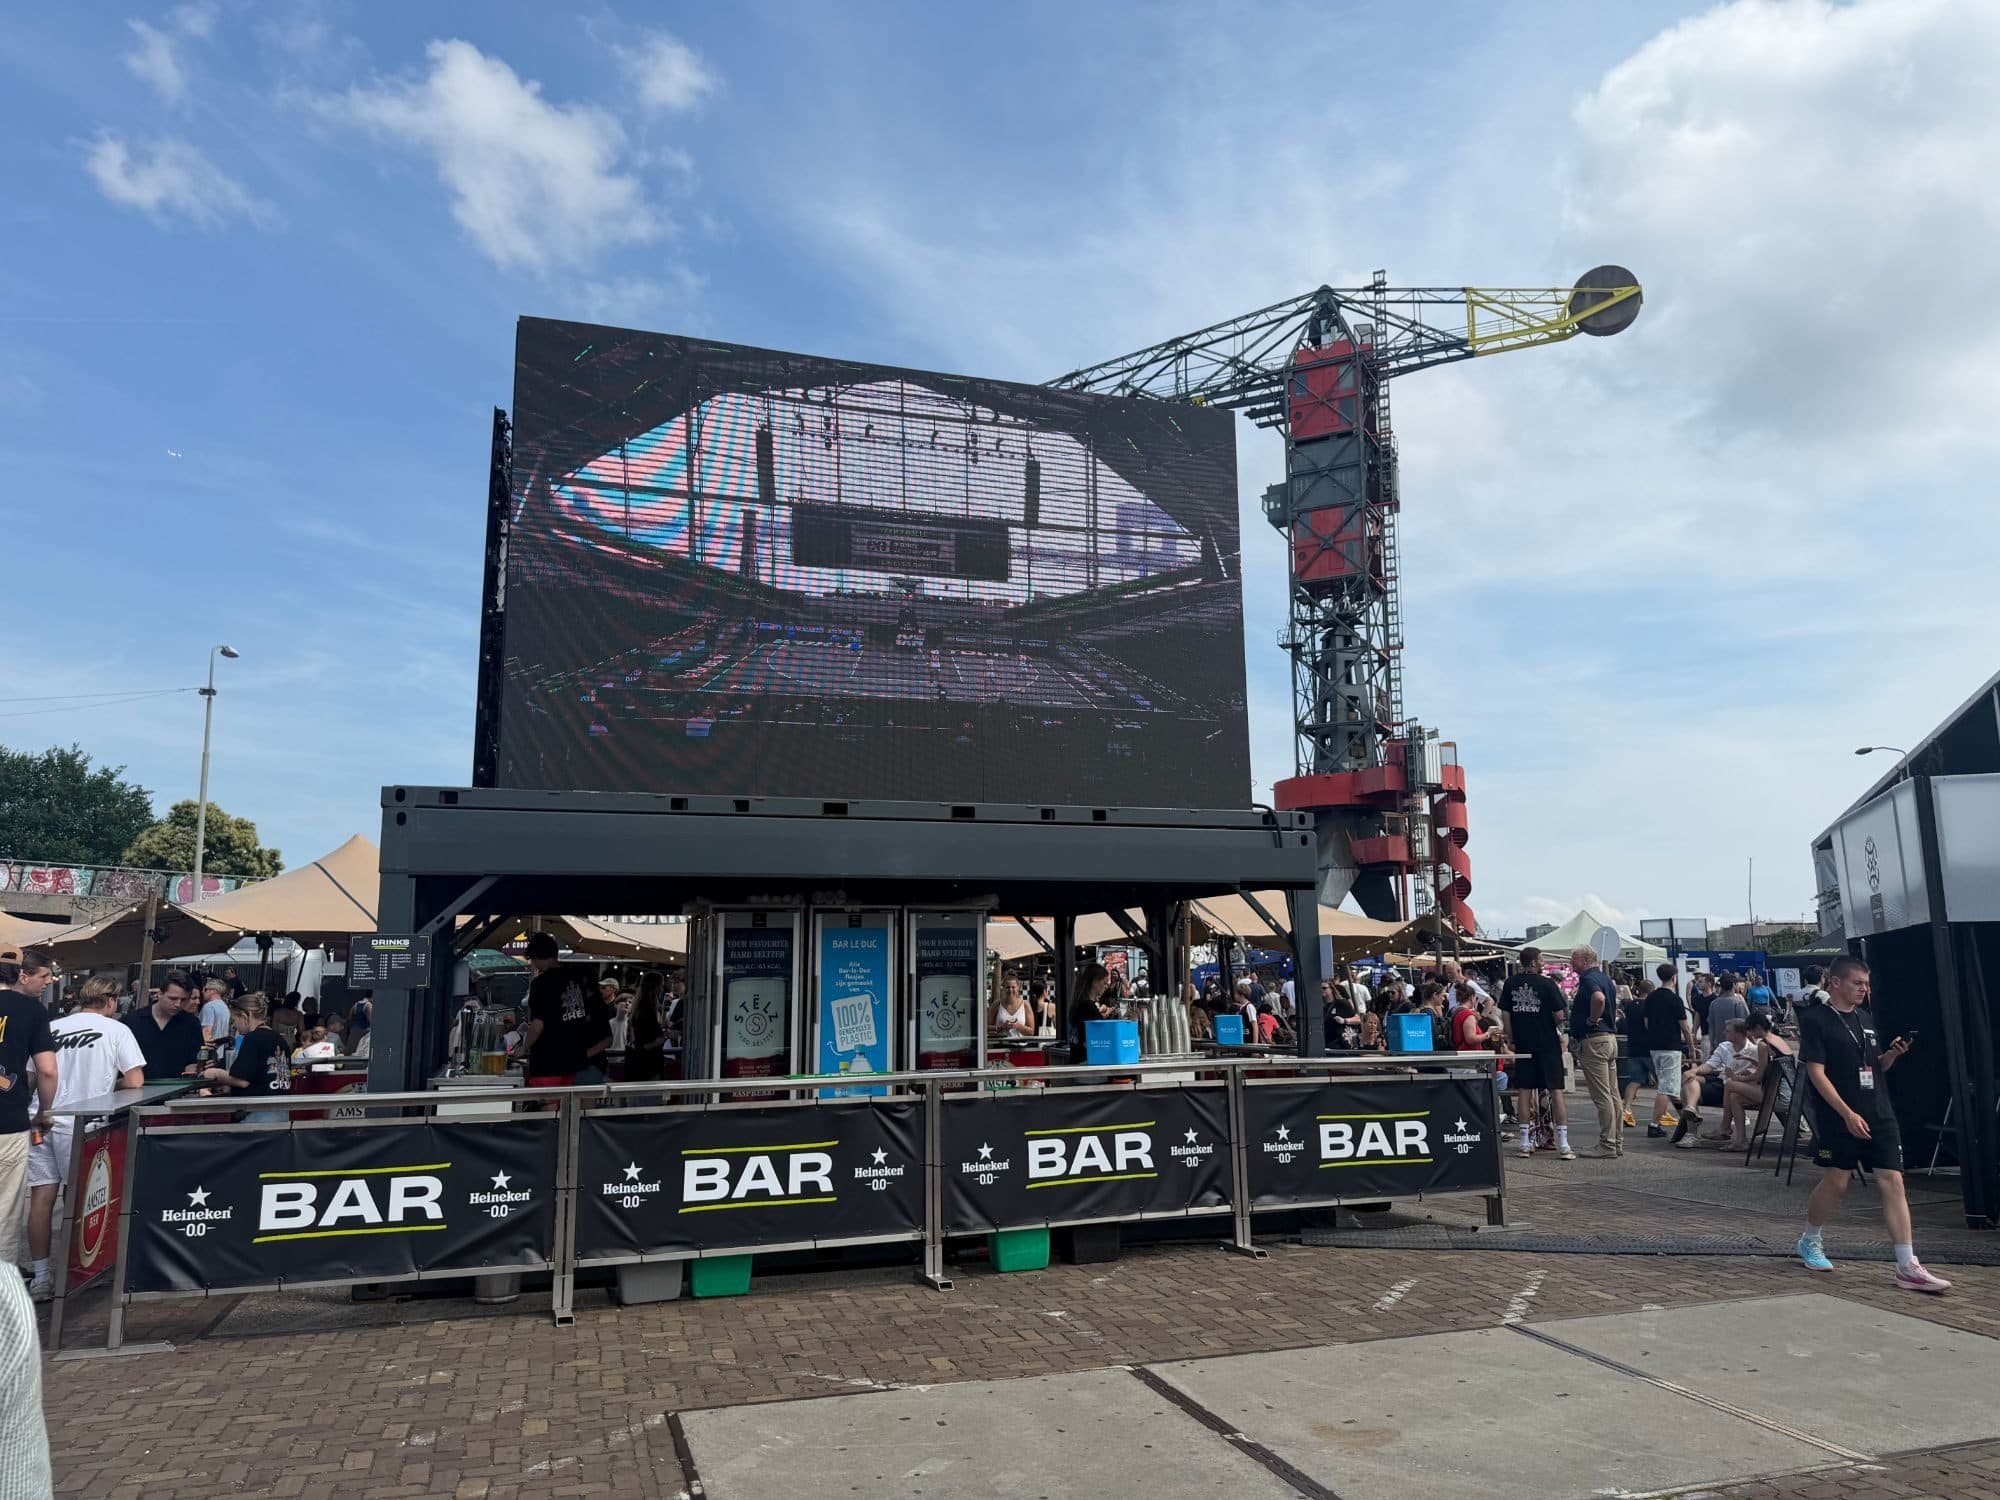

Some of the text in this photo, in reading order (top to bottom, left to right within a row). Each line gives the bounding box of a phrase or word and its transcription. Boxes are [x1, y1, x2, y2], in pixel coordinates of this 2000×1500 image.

[832, 940, 877, 948] BAR LE DUC
[734, 994, 778, 1023] STËLZ
[837, 1001, 870, 1027] 100%
[840, 1031, 872, 1044] PLASTIC
[1319, 1121, 1430, 1159] BAR
[1444, 1132, 1481, 1143] Heineken
[1171, 1144, 1213, 1156] Heineken
[1263, 1140, 1304, 1152] Heineken
[1028, 1132, 1154, 1178] BAR
[855, 1165, 904, 1178] Heineken
[962, 1159, 1010, 1173] Heineken
[683, 1152, 834, 1202] BAR
[603, 1180, 661, 1195] Heineken
[87, 1187, 107, 1210] AMSTEL
[259, 1175, 444, 1230] BAR
[469, 1189, 532, 1205] Heineken
[162, 1206, 234, 1222] Heineken
